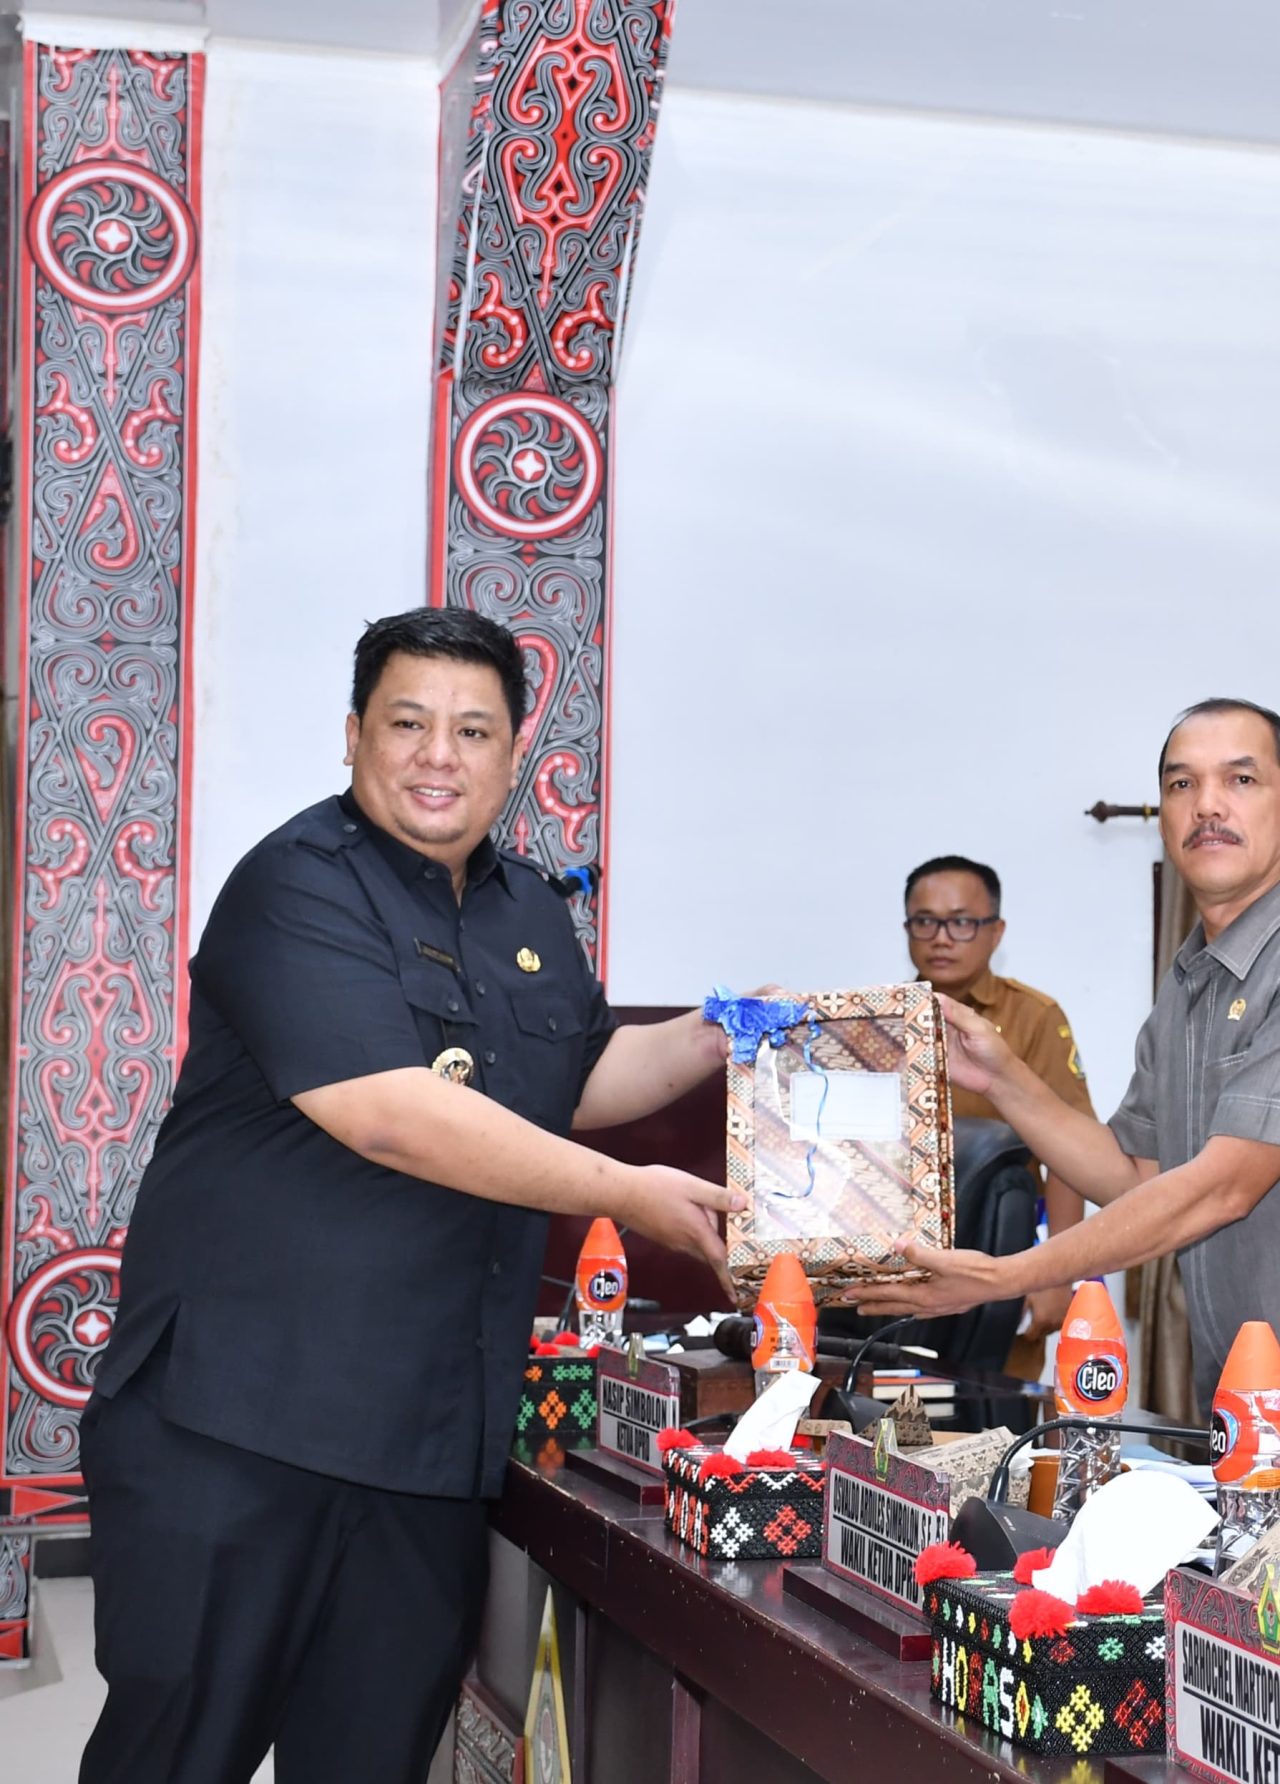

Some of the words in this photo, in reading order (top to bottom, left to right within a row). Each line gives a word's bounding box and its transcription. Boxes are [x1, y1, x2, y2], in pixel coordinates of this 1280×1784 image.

[625, 1387, 667, 1430] SIMBOLON
[1082, 1366, 1116, 1391] Cleo
[1212, 1429, 1227, 1453] eo
[841, 1525, 866, 1576] WAKIL
[867, 1538, 893, 1591] KETUA
[942, 1637, 1014, 1738] HORAS
[1182, 1629, 1233, 1707] SARHOCHEL
[1200, 1704, 1250, 1783] WAKIL
